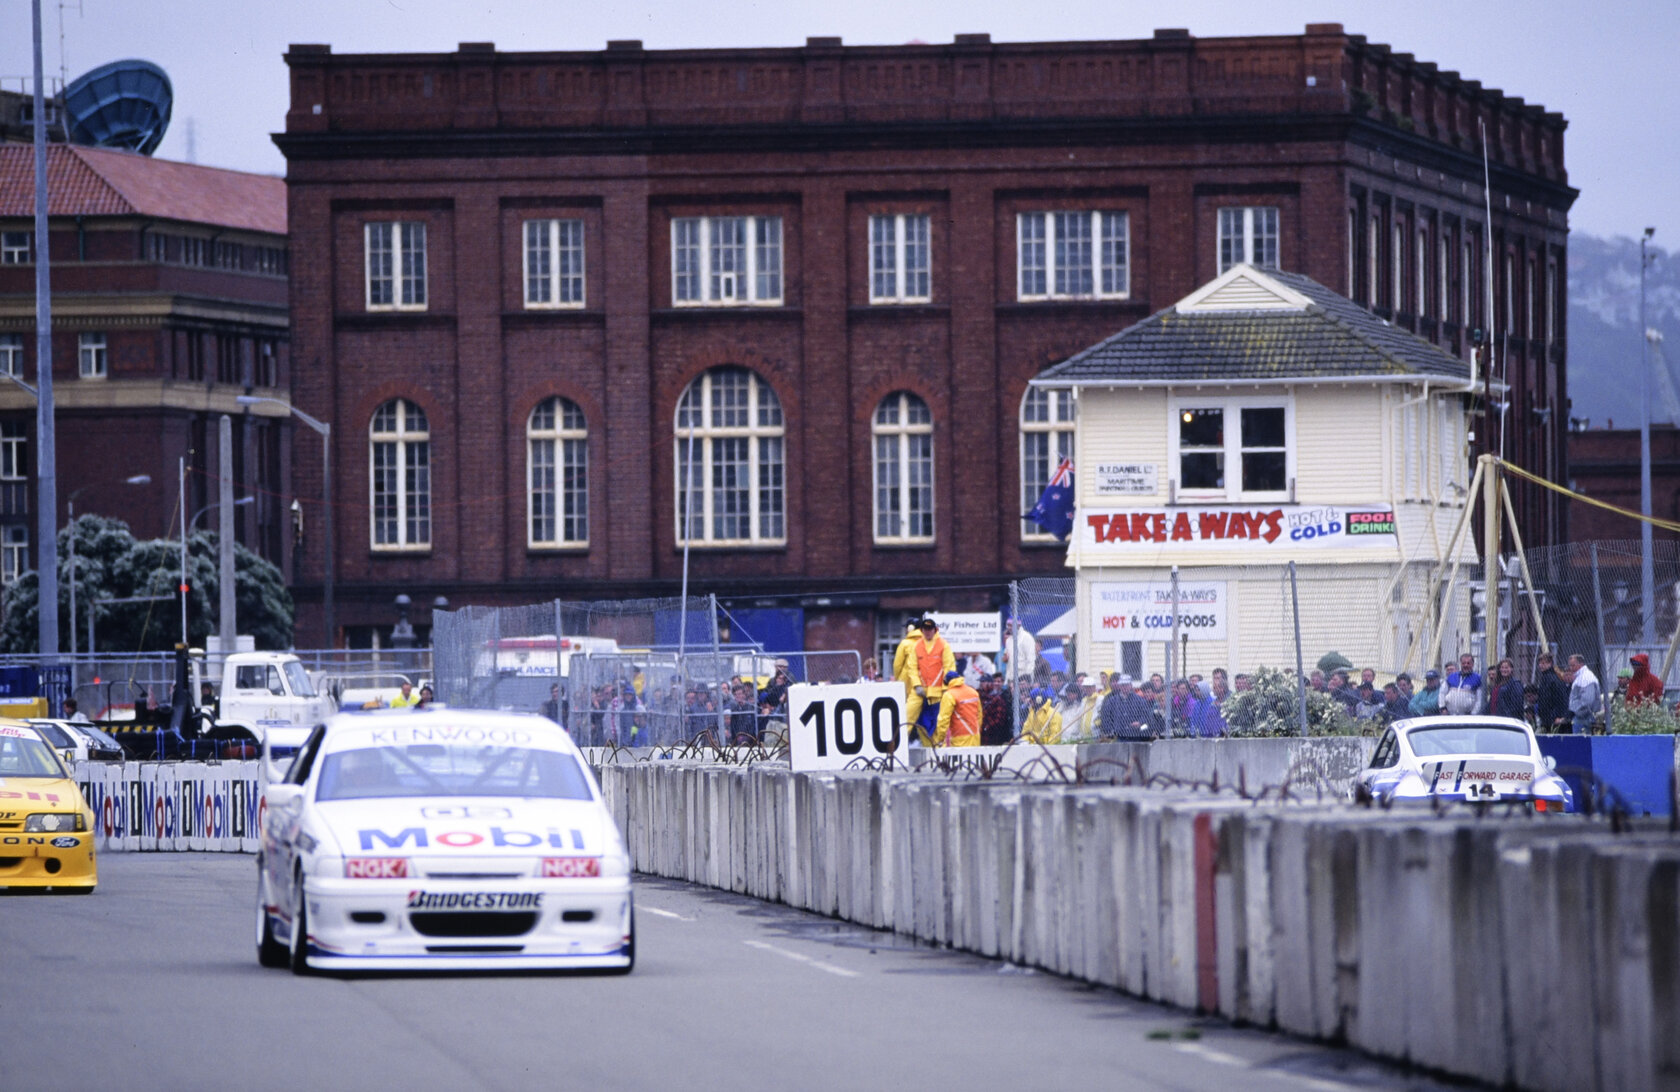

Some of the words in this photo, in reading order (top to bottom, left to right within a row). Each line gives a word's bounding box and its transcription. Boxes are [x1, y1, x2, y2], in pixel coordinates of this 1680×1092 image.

[1288, 509, 1323, 528] HOT
[1290, 521, 1342, 541] COLD
[953, 621, 979, 629] Fisher
[983, 621, 997, 629] Ltd
[1102, 615, 1126, 629] HOT
[1130, 615, 1140, 628] &
[1144, 615, 1173, 628] COLD
[1178, 614, 1216, 627] FOODS
[371, 727, 532, 743] KENWOOD
[799, 697, 900, 757] 100
[1433, 770, 1454, 780] FAST
[1456, 770, 1497, 780] FORWARD
[1499, 771, 1533, 781] GARAGE
[1469, 784, 1495, 797] 14
[93, 781, 128, 838] Mobil
[131, 780, 142, 836] 1
[143, 781, 180, 839] Mobil
[182, 780, 193, 837] 1
[194, 780, 229, 838] Mobil
[358, 826, 585, 850] Mobil
[349, 858, 398, 878] NGK
[545, 858, 590, 877] NGK
[408, 890, 545, 909] BRIDGESTONE
